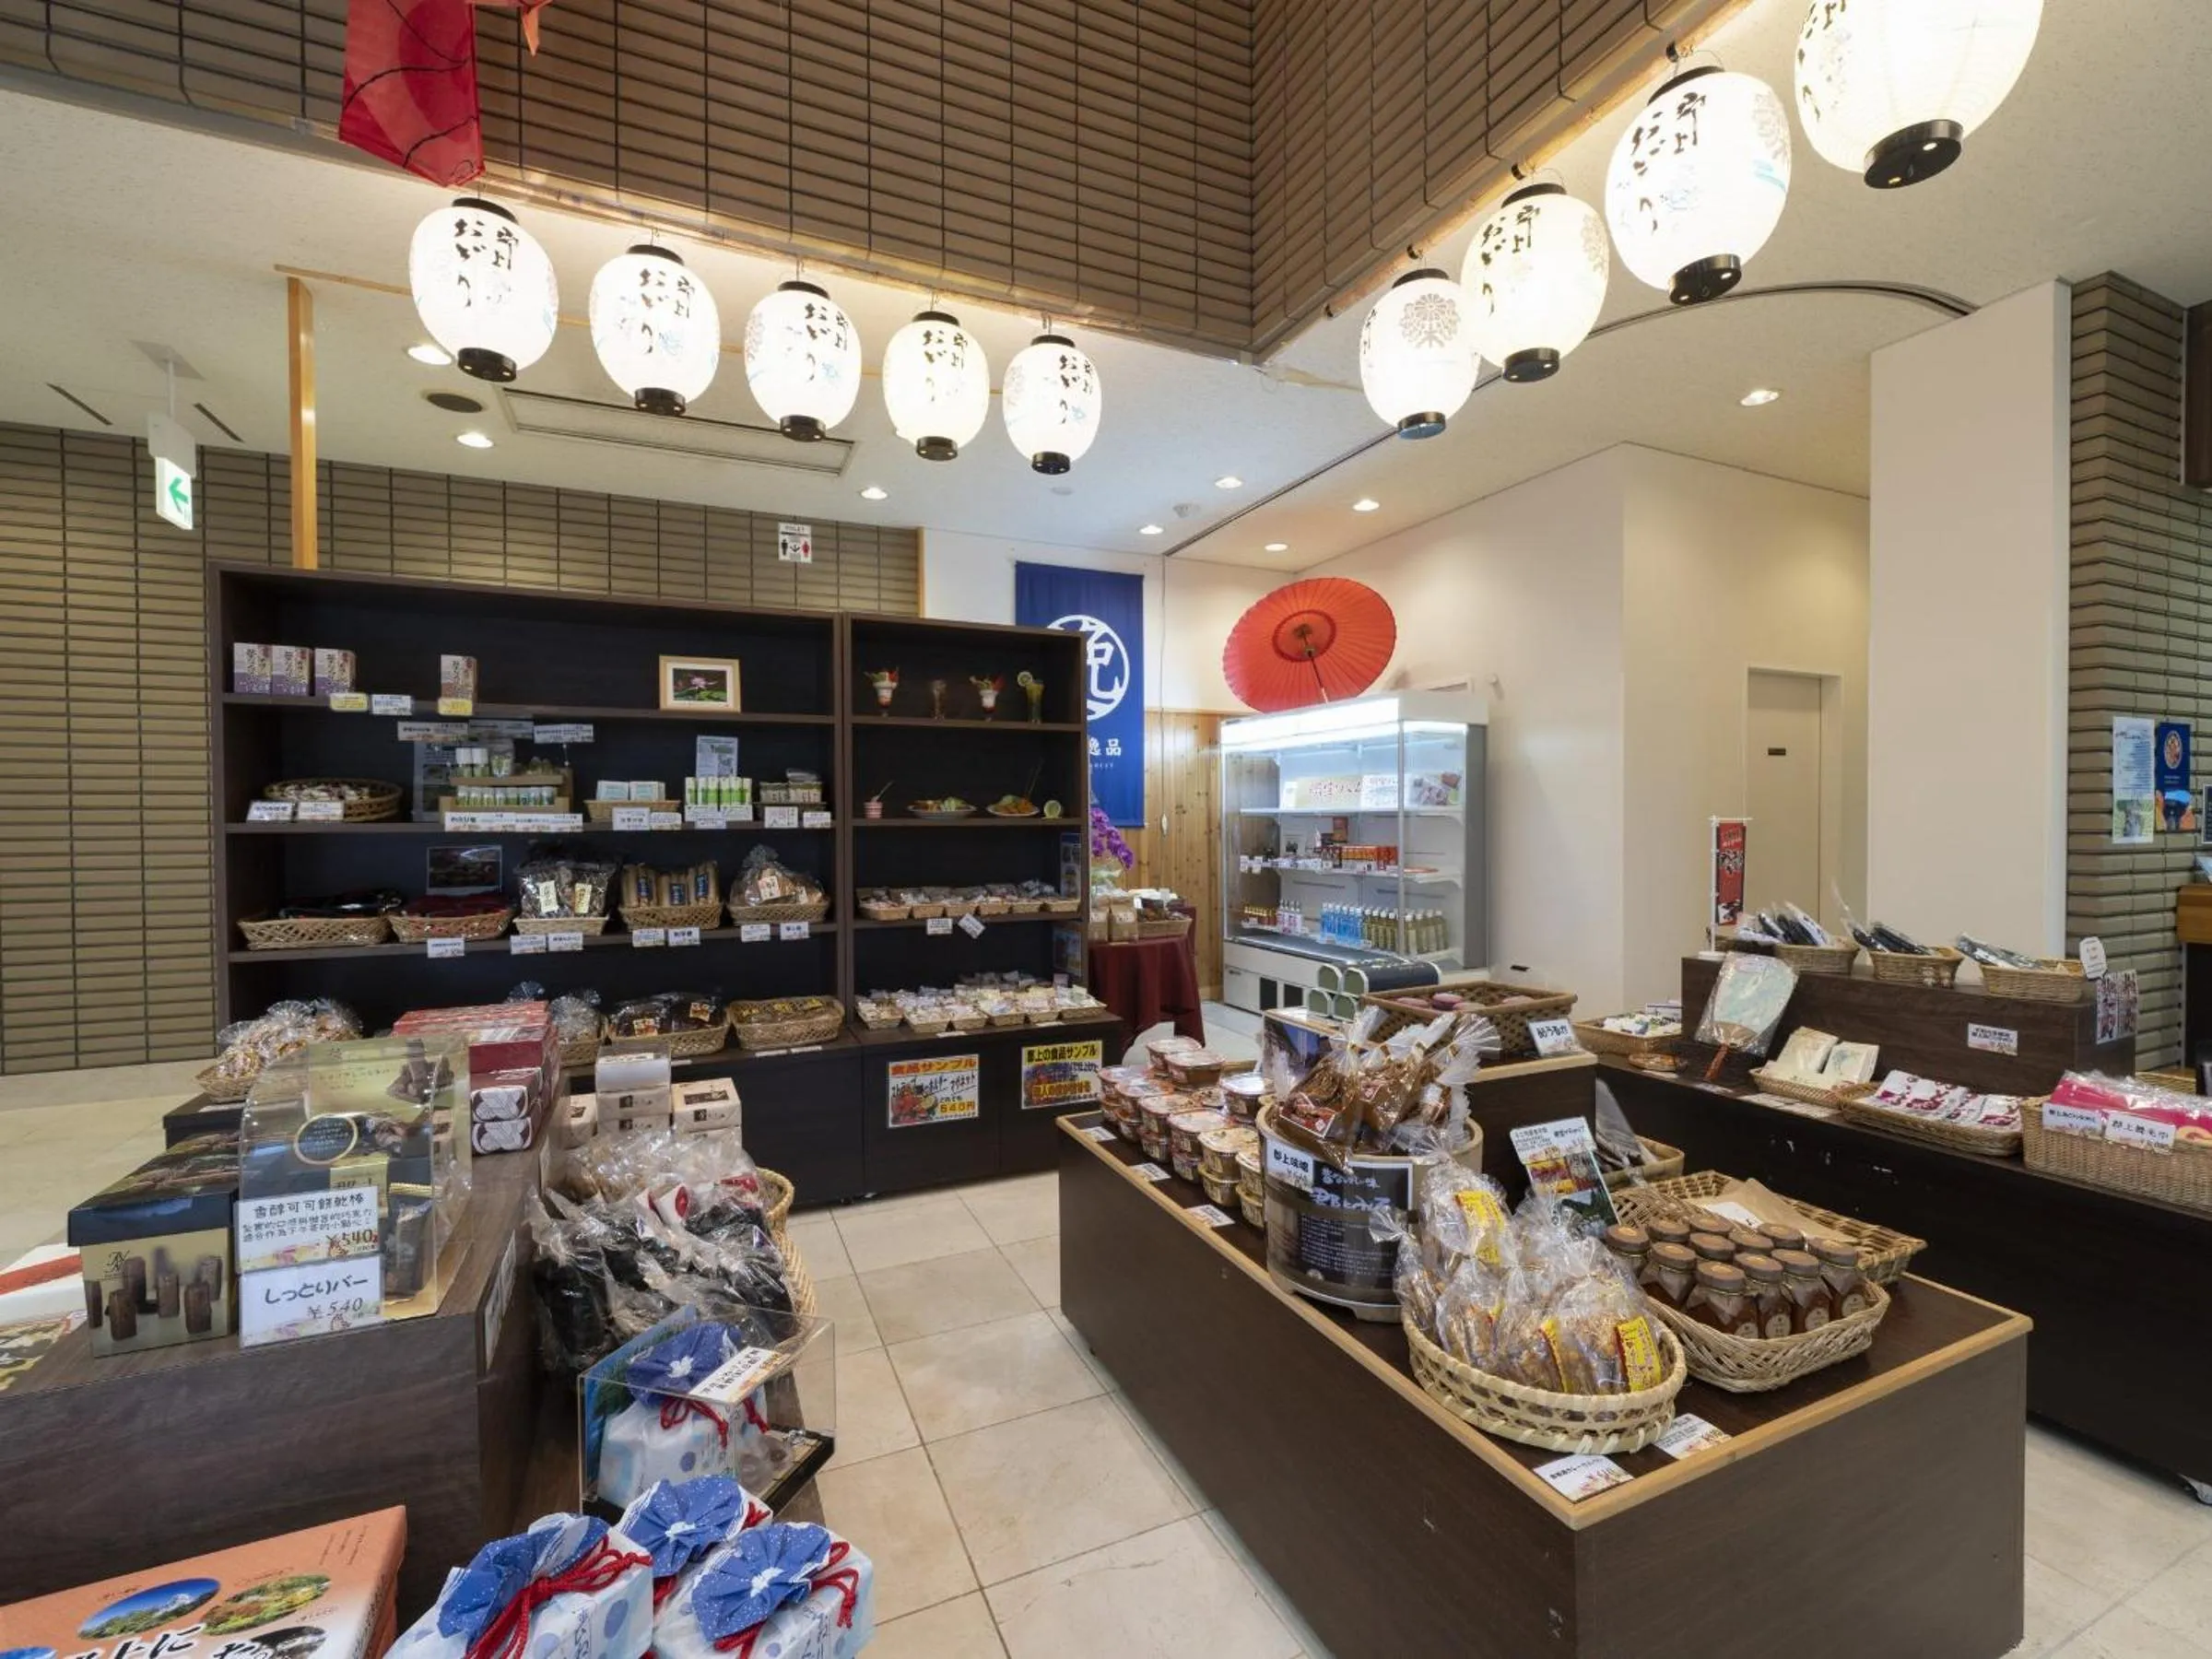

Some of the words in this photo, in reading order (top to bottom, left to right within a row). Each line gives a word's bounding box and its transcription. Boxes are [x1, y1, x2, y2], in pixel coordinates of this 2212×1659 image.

[1630, 111, 1665, 235] おどり
[454, 218, 488, 308] おどり
[1479, 216, 1507, 317] おどり
[639, 267, 670, 355] おどり
[804, 302, 831, 382] おどり
[922, 329, 947, 403] おどり
[1058, 354, 1079, 425] おどり
[890, 1058, 977, 1077] 食品サンプル
[1027, 1043, 1097, 1064] 郡上の食品サンプル
[1273, 1147, 1310, 1173] 郡上味噌
[253, 1192, 365, 1219] 香醇可可餅乾棒
[265, 1275, 370, 1305] しっとりバー
